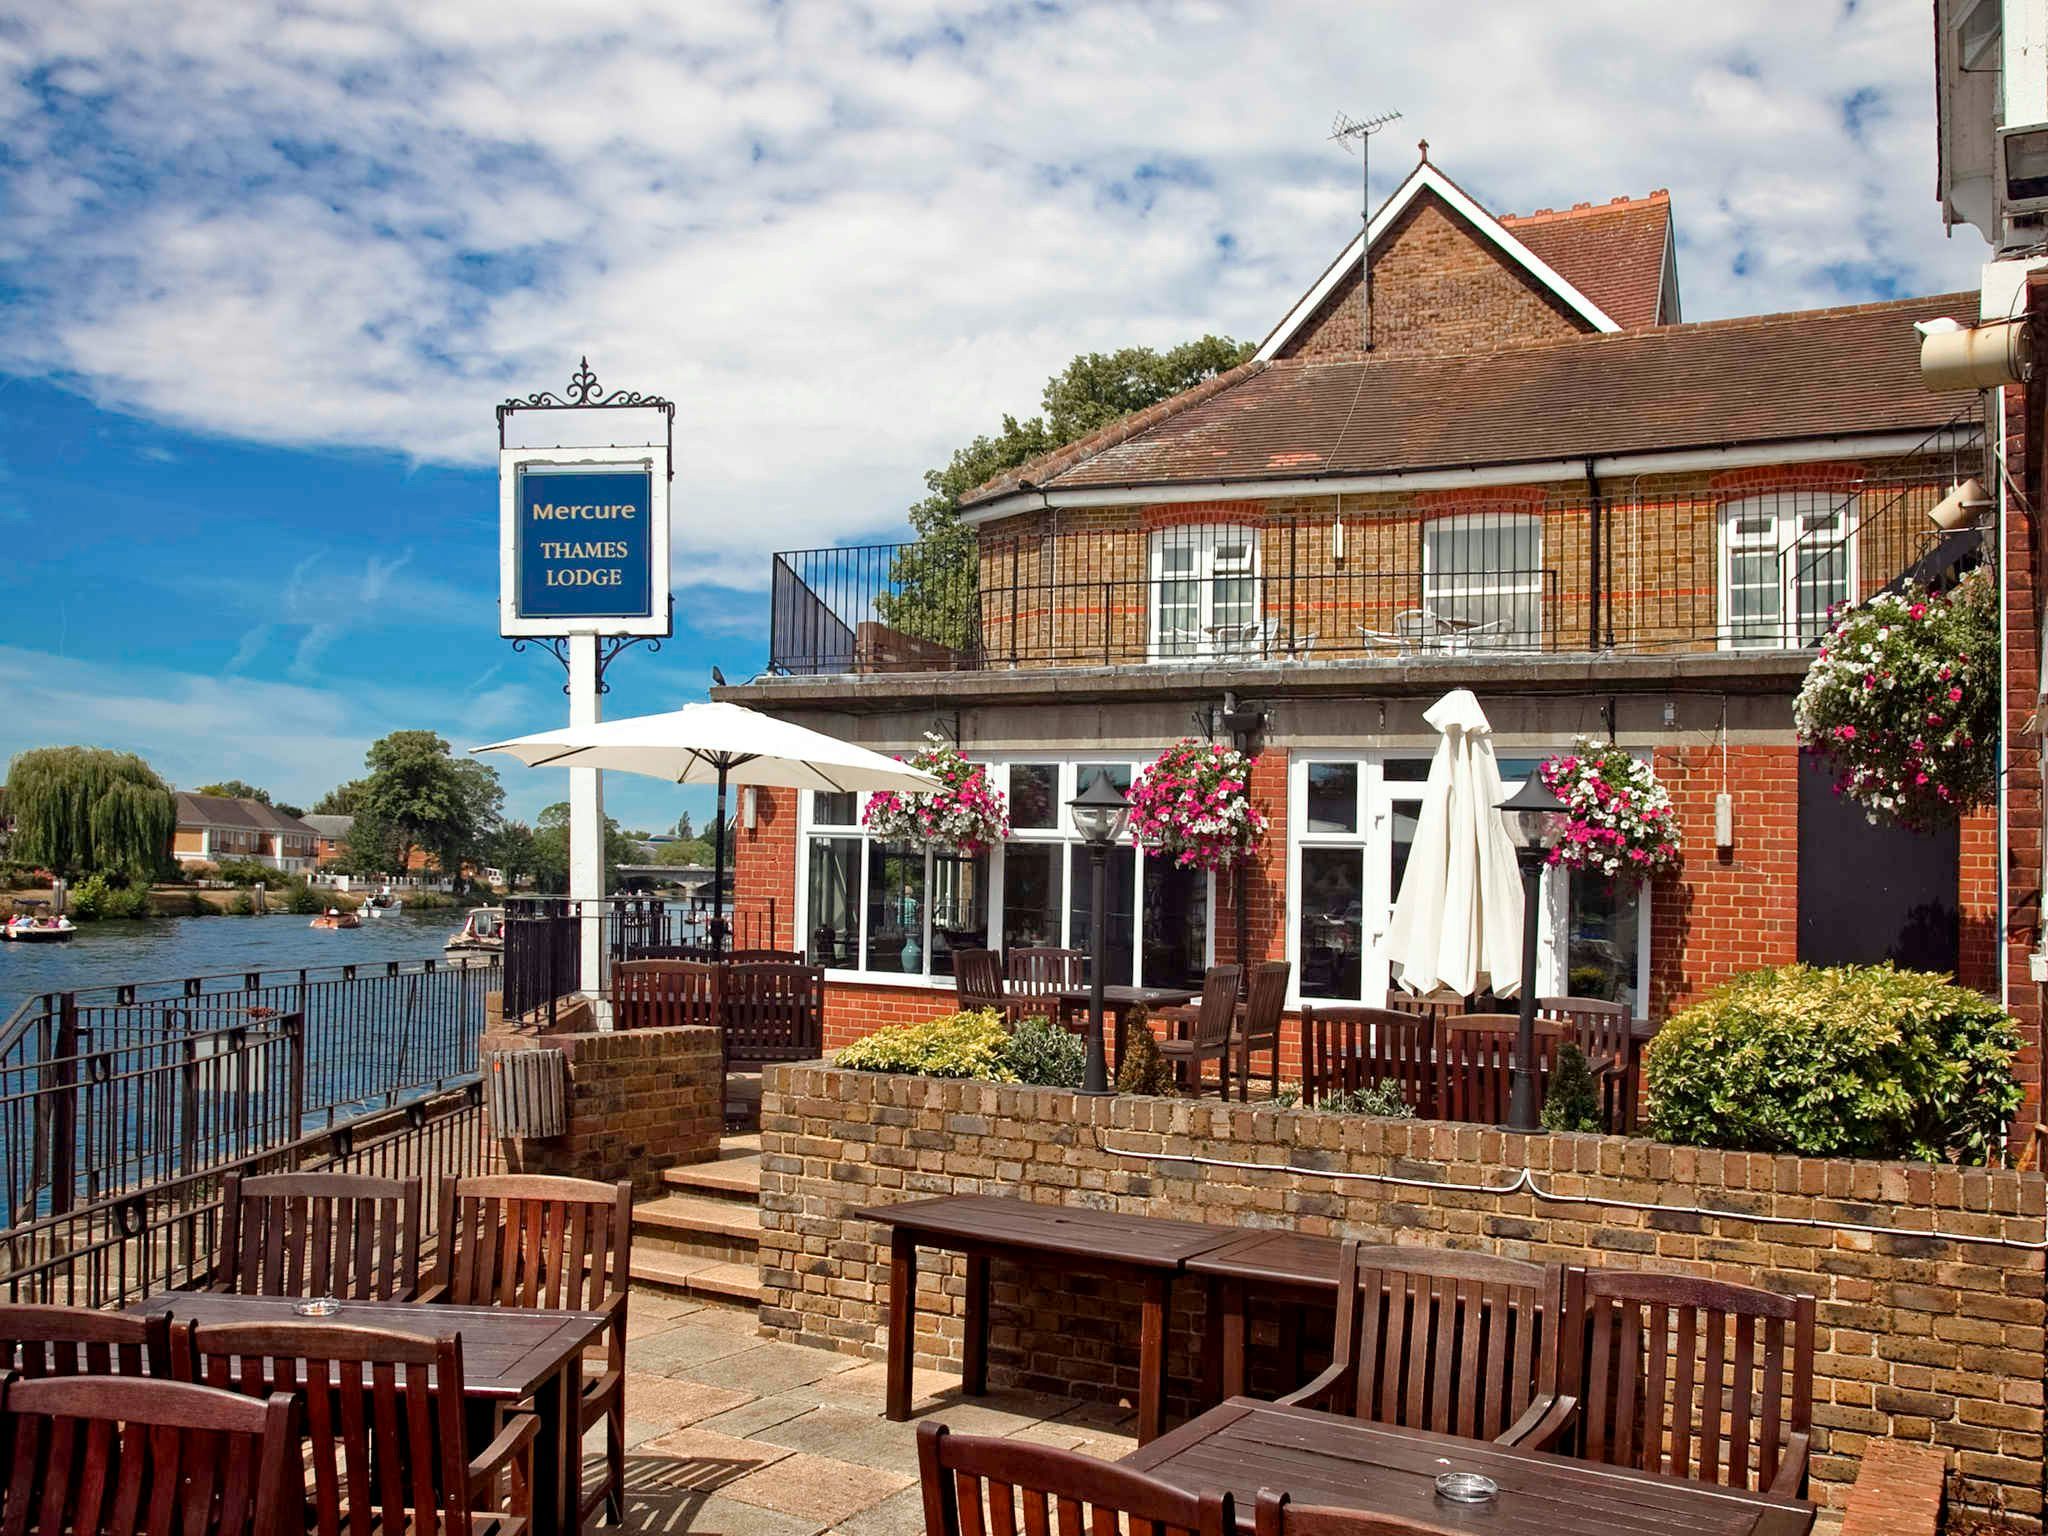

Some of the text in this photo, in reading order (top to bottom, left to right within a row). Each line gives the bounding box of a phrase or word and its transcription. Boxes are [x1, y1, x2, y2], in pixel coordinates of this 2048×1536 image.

[532, 503, 636, 520] Mercure
[540, 541, 628, 559] THAMES
[546, 568, 623, 586] LODGE
